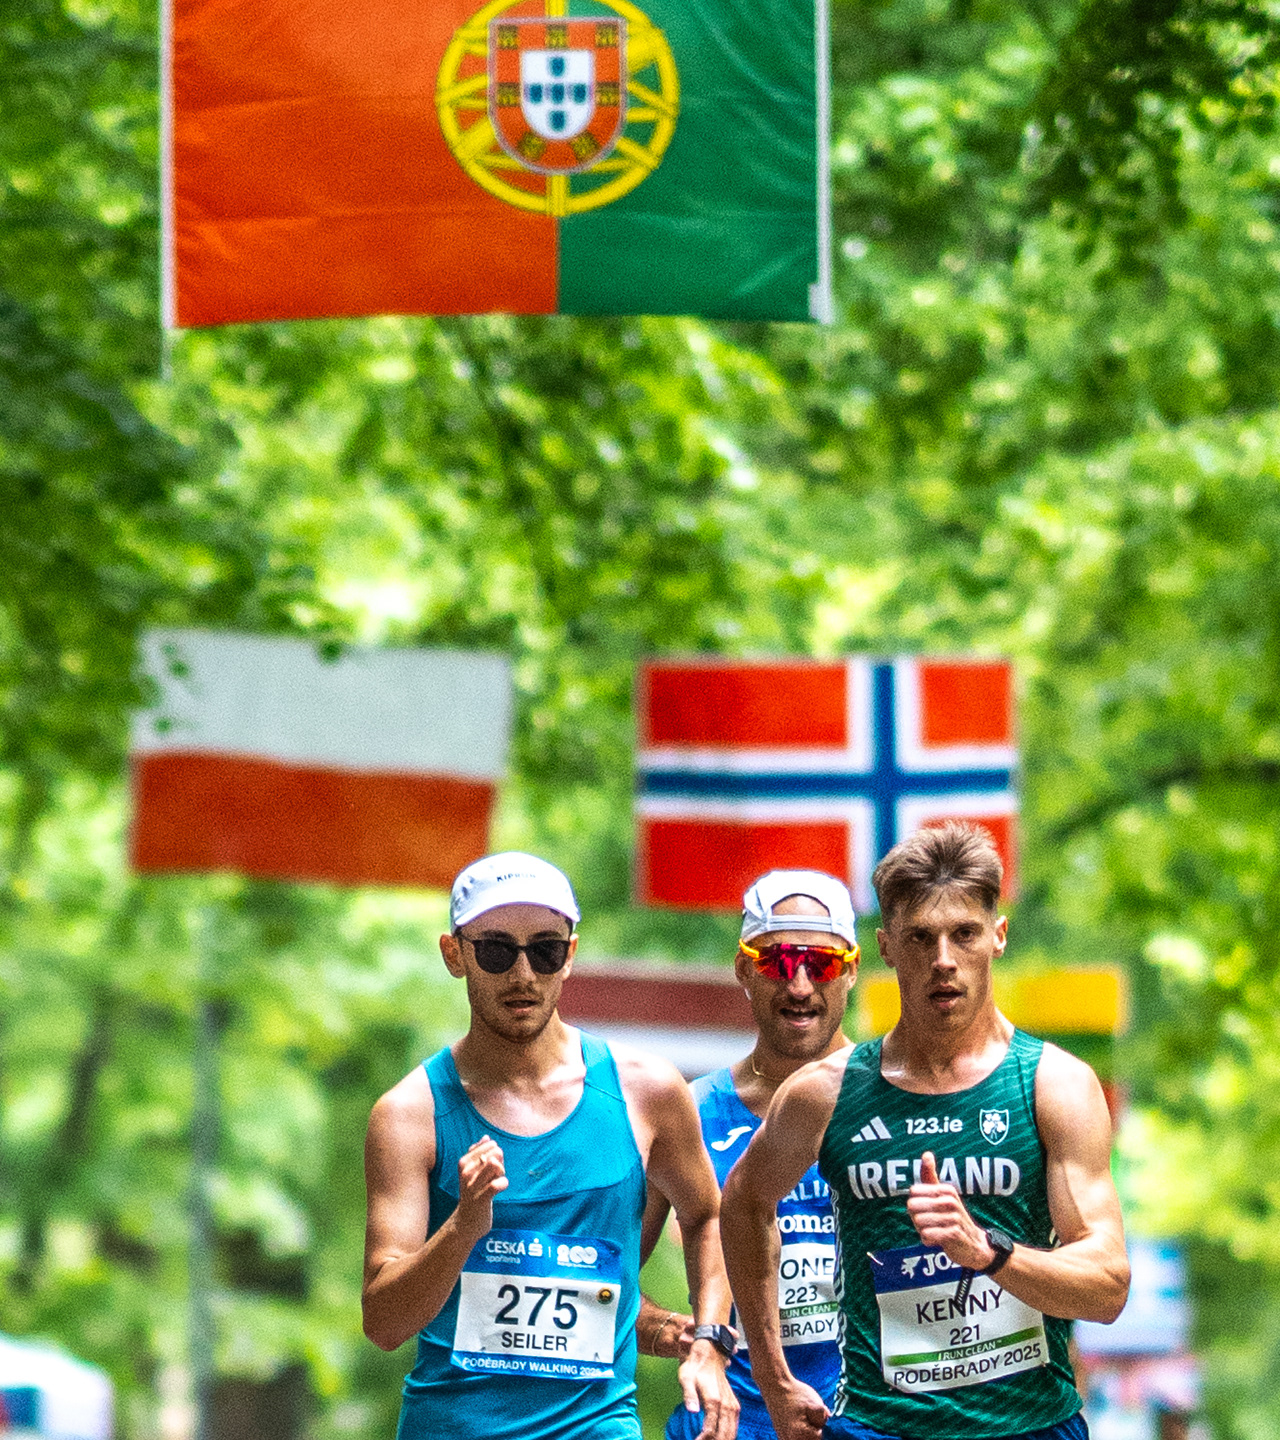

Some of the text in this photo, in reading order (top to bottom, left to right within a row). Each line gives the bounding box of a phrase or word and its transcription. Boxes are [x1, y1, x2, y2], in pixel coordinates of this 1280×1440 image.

[905, 1116, 964, 1134] 123.ie
[776, 1213, 835, 1233] oma
[486, 1239, 525, 1255] ČESKÁ
[922, 1252, 962, 1276] JO
[784, 1285, 818, 1305] 223
[495, 1283, 579, 1330] 275
[801, 1304, 831, 1317] CLEAN
[916, 1288, 1003, 1324] KENNY
[500, 1331, 568, 1352] SEILER
[949, 1324, 980, 1346] 221
[943, 1348, 965, 1360] RUN
[965, 1341, 996, 1355] CLEAN
[529, 1362, 578, 1374] WALKING
[893, 1343, 1042, 1386] PODĚBRADY 2025
